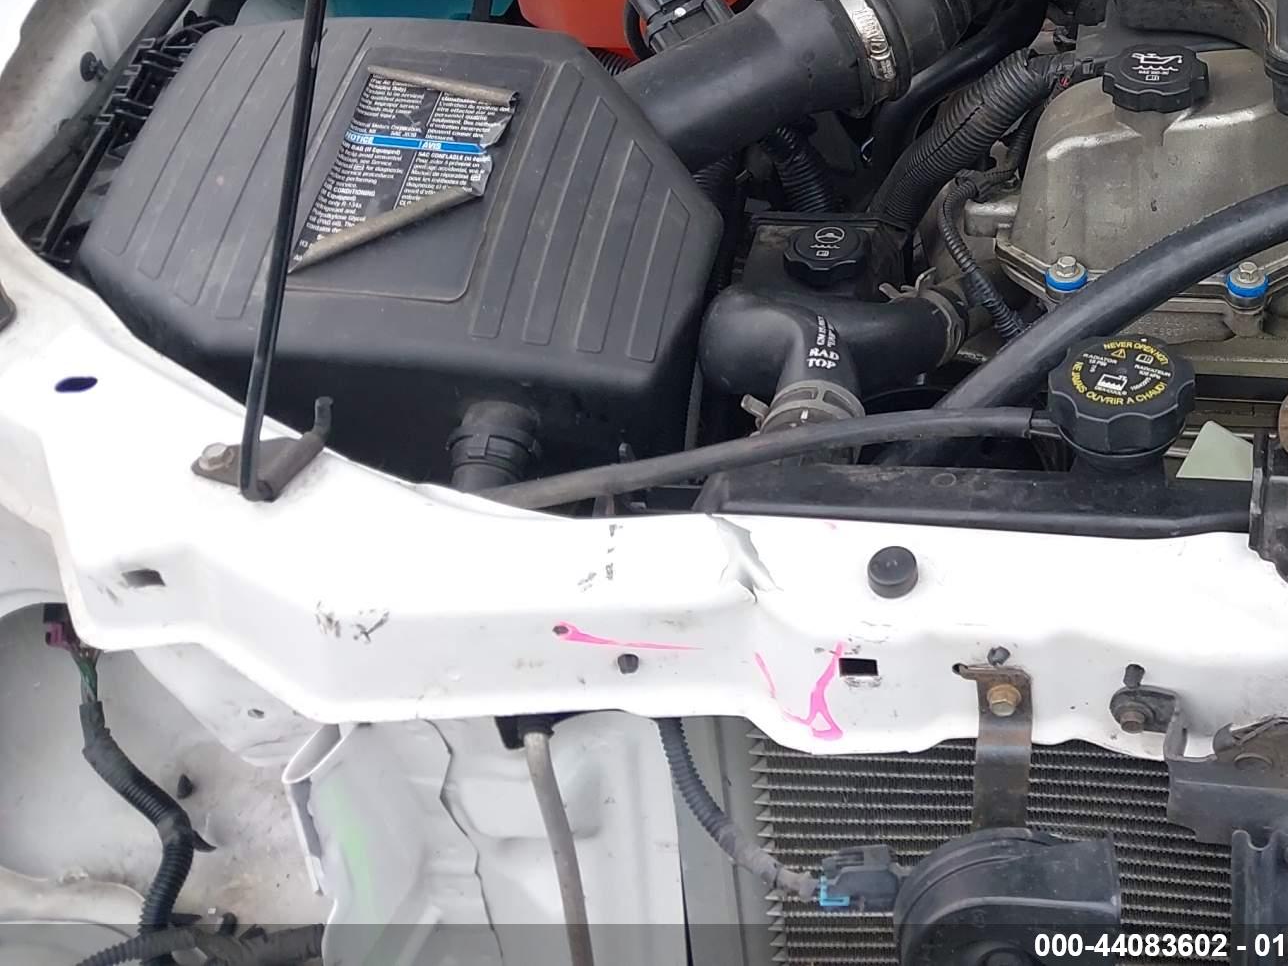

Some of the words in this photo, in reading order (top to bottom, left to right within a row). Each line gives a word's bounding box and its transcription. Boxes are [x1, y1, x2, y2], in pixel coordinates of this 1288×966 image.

[346, 131, 374, 144] NOTICE
[421, 141, 442, 150] AVIS
[809, 347, 840, 360] RAD
[1103, 341, 1133, 350] NEVER
[1134, 342, 1155, 354] OPEN
[806, 358, 836, 369] TOP
[1086, 391, 1124, 405] OUVRIR
